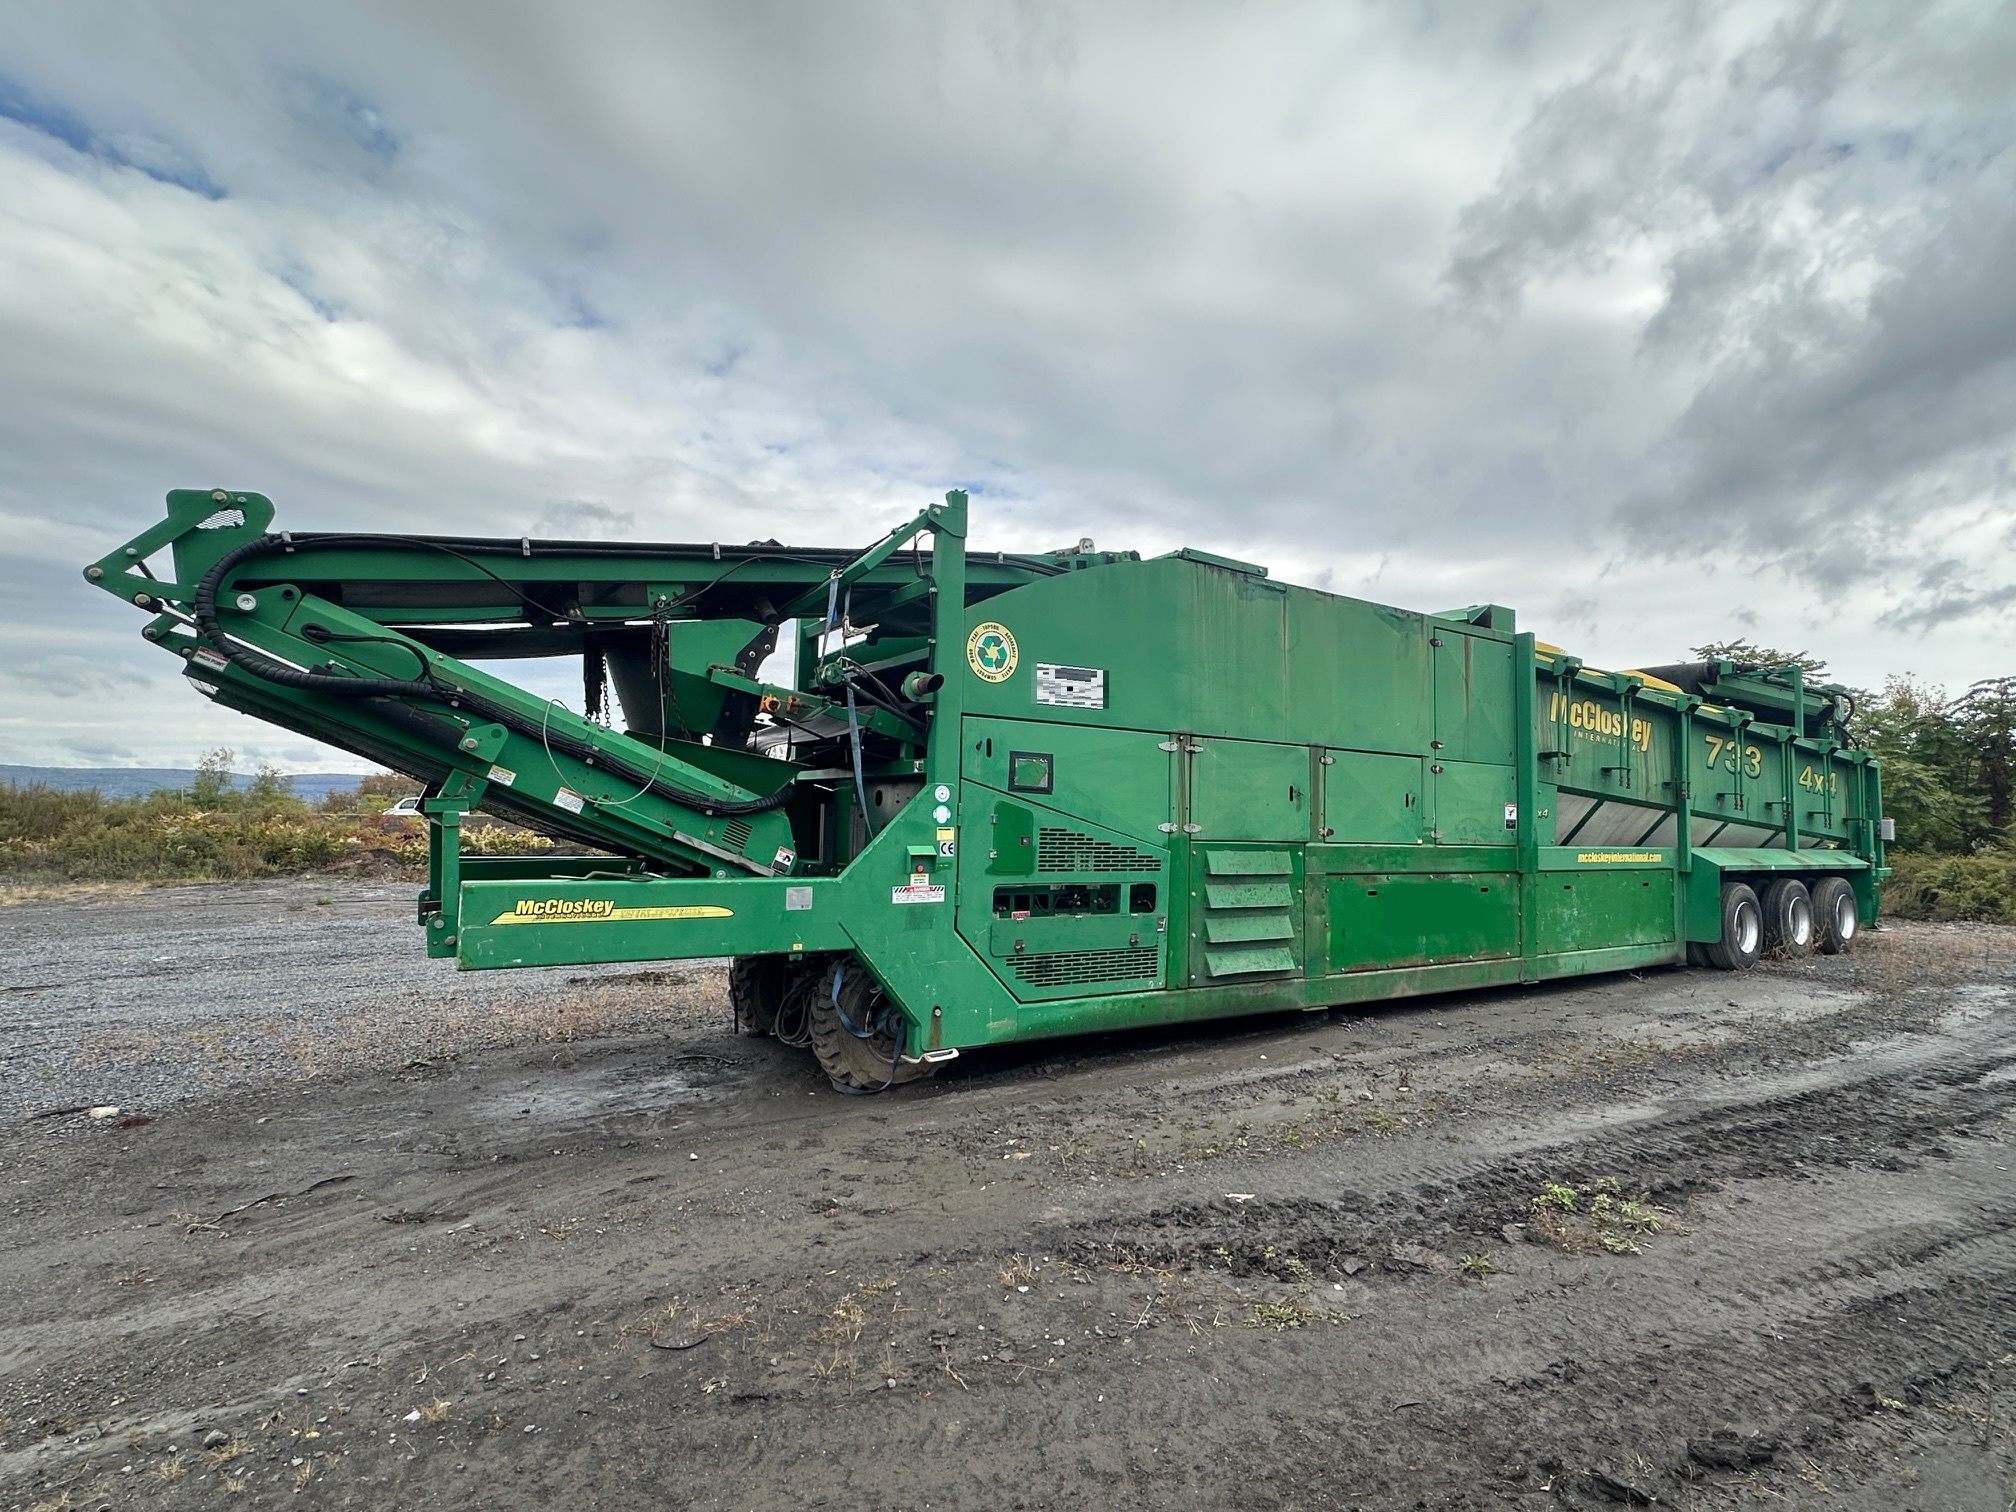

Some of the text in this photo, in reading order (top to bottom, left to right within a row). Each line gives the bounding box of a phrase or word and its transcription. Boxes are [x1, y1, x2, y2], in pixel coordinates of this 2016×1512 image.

[970, 630, 979, 643] PEAT
[1004, 632, 1017, 659] AGGREGATE
[196, 653, 211, 662] PINCH
[211, 658, 225, 667] POINT
[1705, 734, 1762, 780] 733
[1798, 765, 1837, 799] 4x4
[941, 842, 953, 855] CE
[1577, 852, 1662, 863] mccloskeyinternational.com
[515, 899, 615, 916] McCloskey
